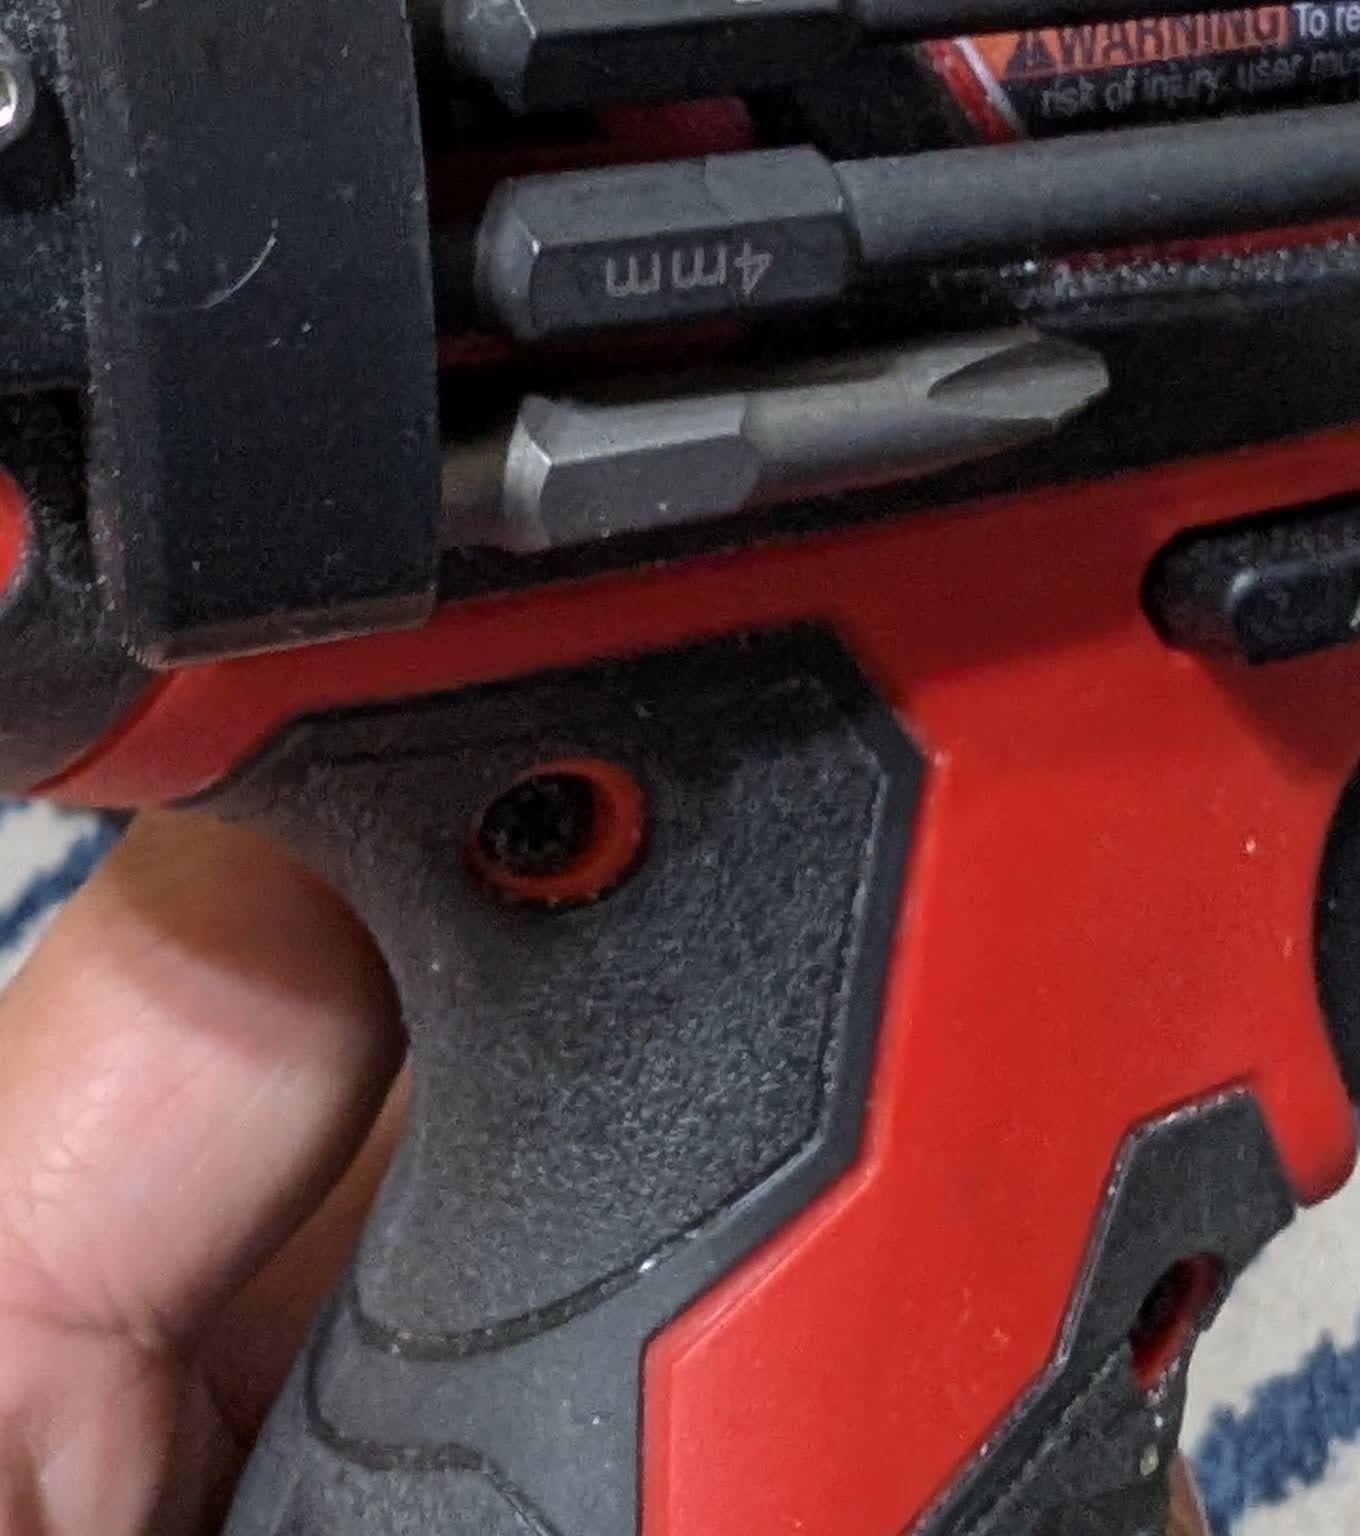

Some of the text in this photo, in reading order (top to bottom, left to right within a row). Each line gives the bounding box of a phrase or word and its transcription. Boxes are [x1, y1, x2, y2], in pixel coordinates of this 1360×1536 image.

[1060, 7, 1288, 66] WARNING
[1291, 1, 1329, 38] To
[1105, 65, 1139, 113] of
[603, 240, 774, 301] 4mm
